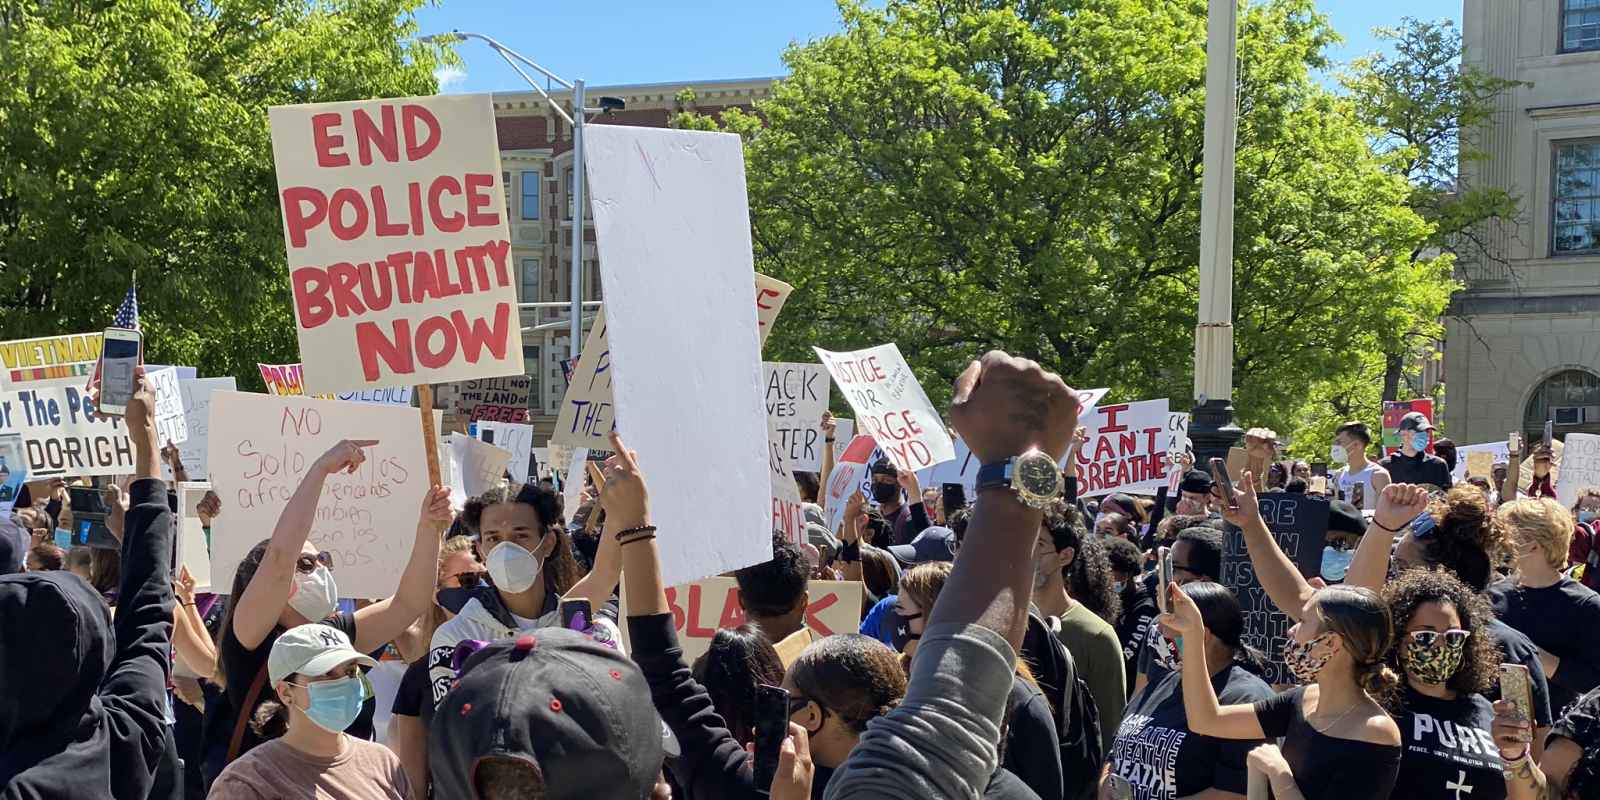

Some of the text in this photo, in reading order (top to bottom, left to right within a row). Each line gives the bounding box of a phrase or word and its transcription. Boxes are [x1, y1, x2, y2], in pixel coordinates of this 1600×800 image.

[312, 105, 441, 168] END
[282, 173, 500, 248] POLICE
[291, 239, 511, 329] BRUTALITY
[355, 302, 510, 382] NOW
[461, 392, 481, 401] THE
[483, 392, 518, 405] LAND
[511, 379, 530, 388] NOT
[18, 390, 60, 428] The
[281, 406, 321, 436] NO
[470, 404, 527, 423] FREE
[1097, 405, 1129, 433] I
[1075, 428, 1162, 465] CAN'T
[1075, 451, 1167, 497] BREATHE
[1412, 713, 1500, 758] PURE
